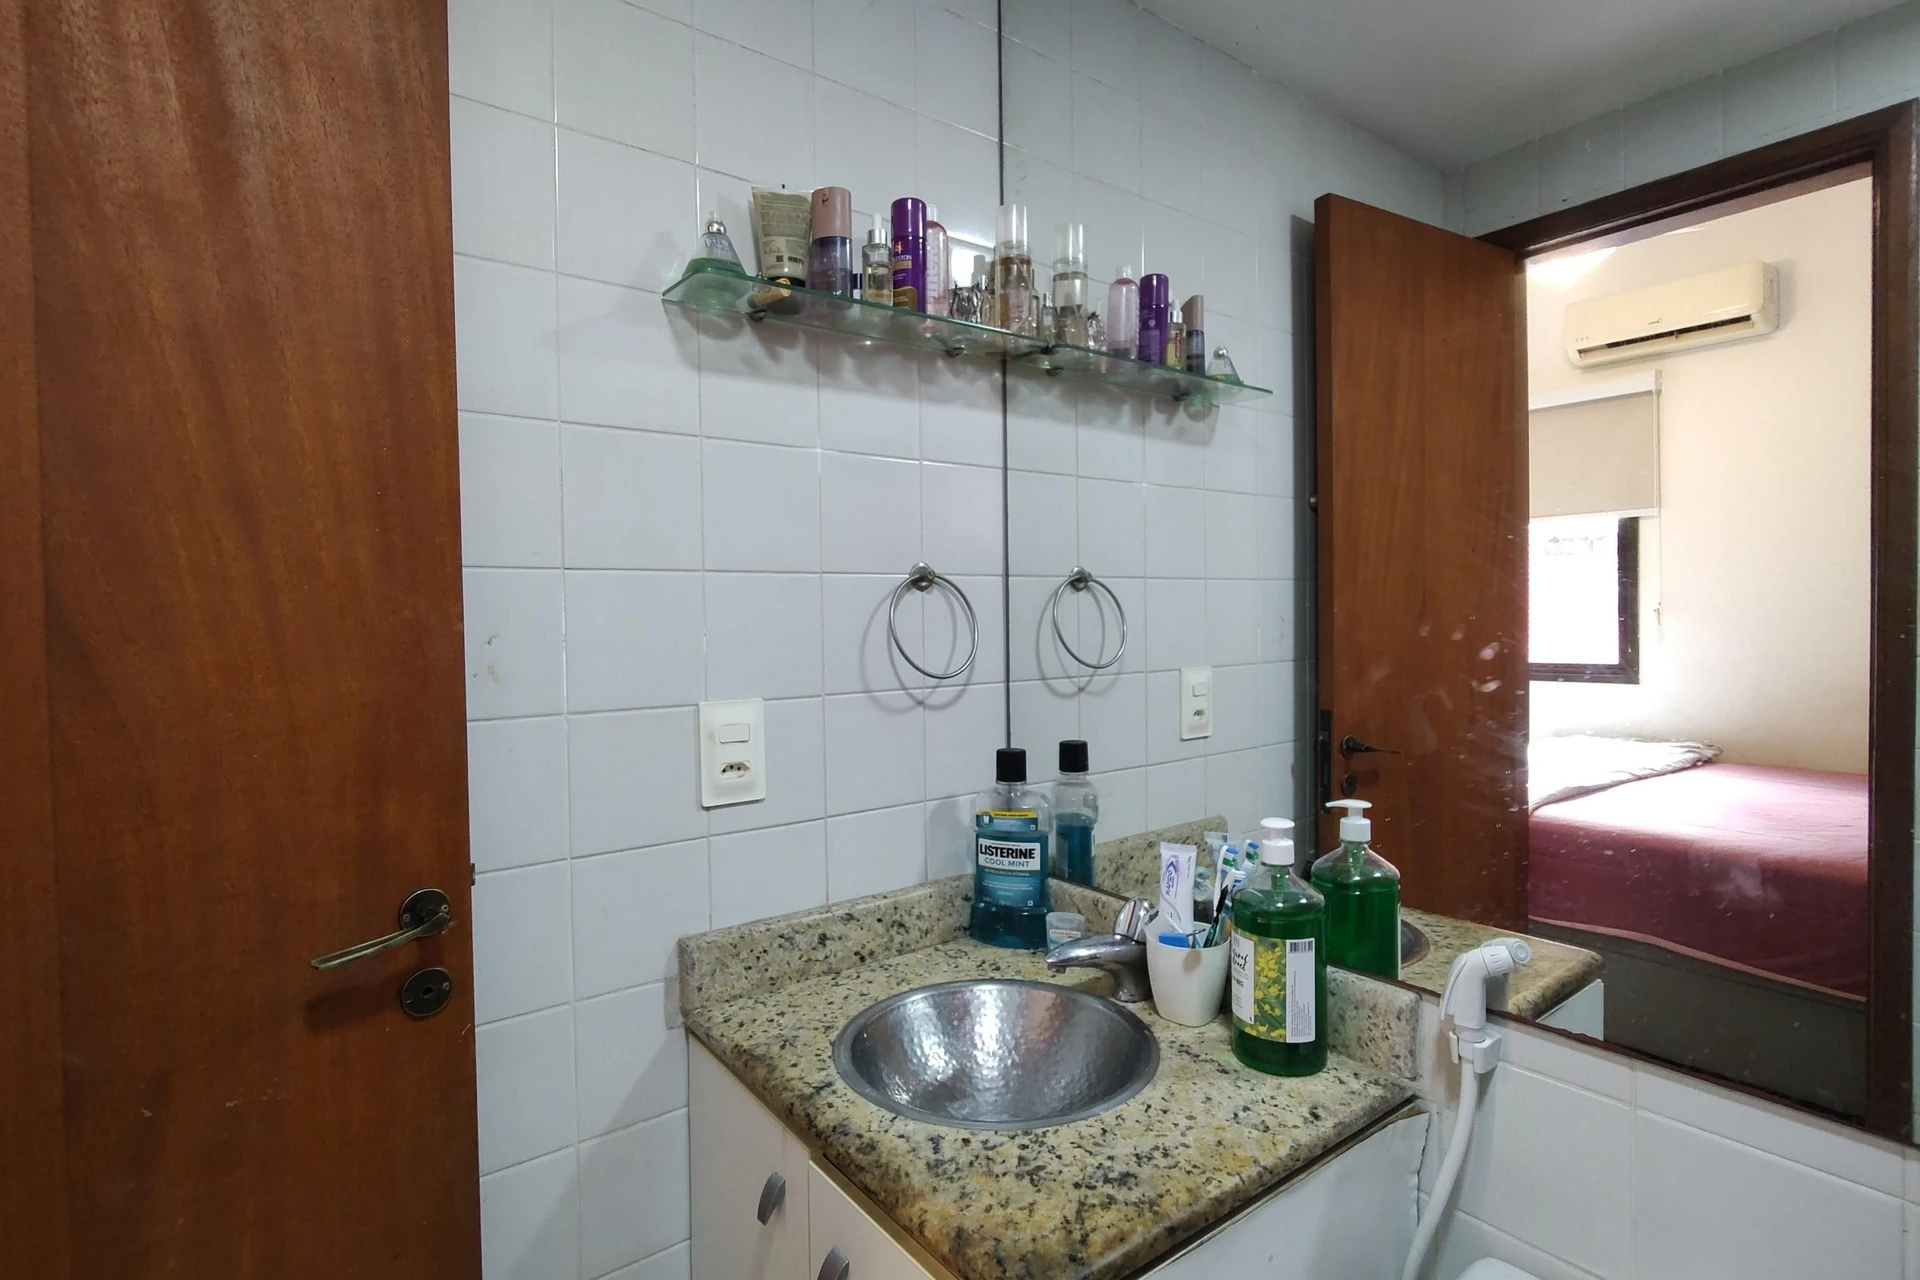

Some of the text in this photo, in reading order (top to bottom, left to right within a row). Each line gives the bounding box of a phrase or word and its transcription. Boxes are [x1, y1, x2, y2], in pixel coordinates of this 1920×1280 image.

[979, 843, 1036, 860] LISTERINE
[984, 857, 1030, 868] COOL MINT
